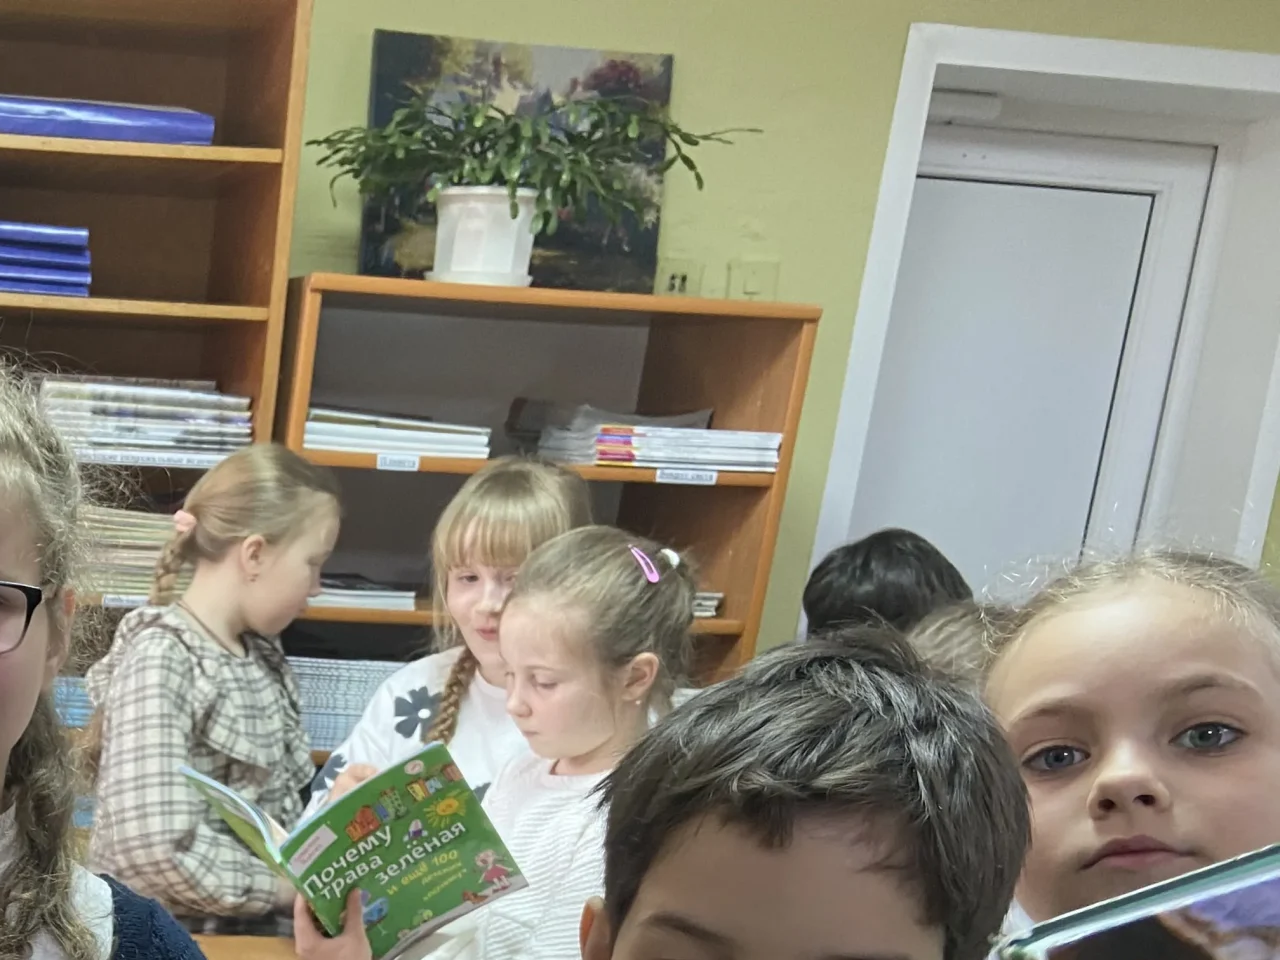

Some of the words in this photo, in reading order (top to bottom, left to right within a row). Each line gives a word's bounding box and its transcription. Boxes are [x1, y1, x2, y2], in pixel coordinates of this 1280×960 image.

[302, 825, 392, 898] Почему
[320, 854, 383, 900] трава
[375, 822, 466, 885] зелёная
[431, 849, 458, 866] 100
